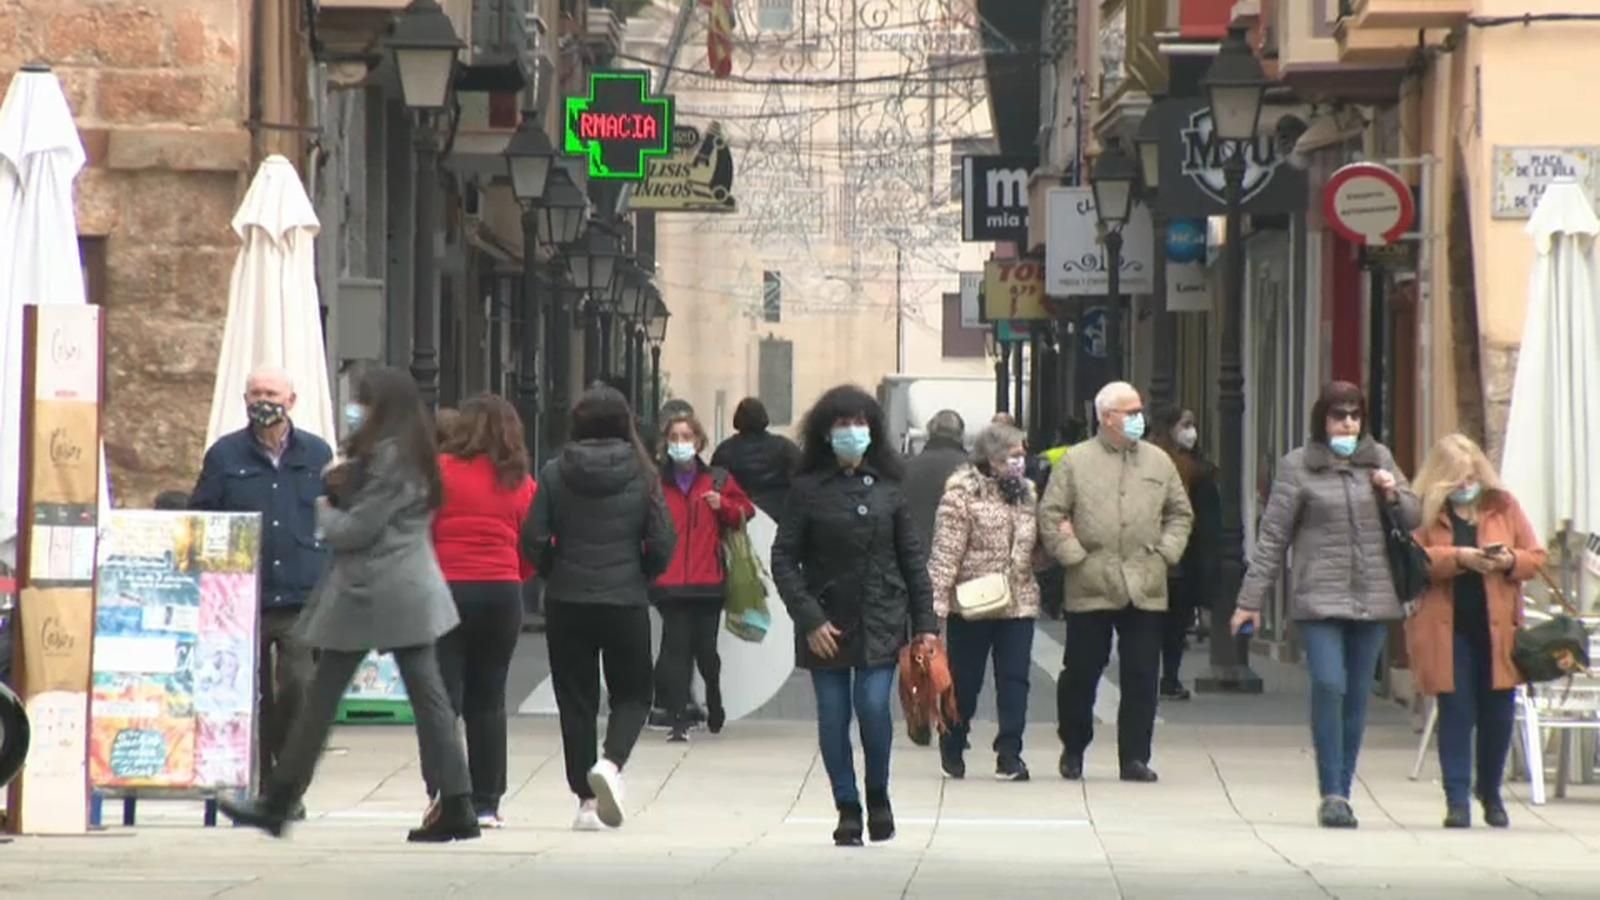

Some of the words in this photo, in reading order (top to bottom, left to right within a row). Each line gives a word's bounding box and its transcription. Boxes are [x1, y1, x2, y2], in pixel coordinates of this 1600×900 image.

[580, 113, 657, 139] RMACIA
[648, 162, 693, 178] LISIS
[1515, 165, 1529, 177] DE
[1533, 165, 1548, 177] LA
[632, 182, 694, 199] INICOS
[986, 211, 1020, 228] mia
